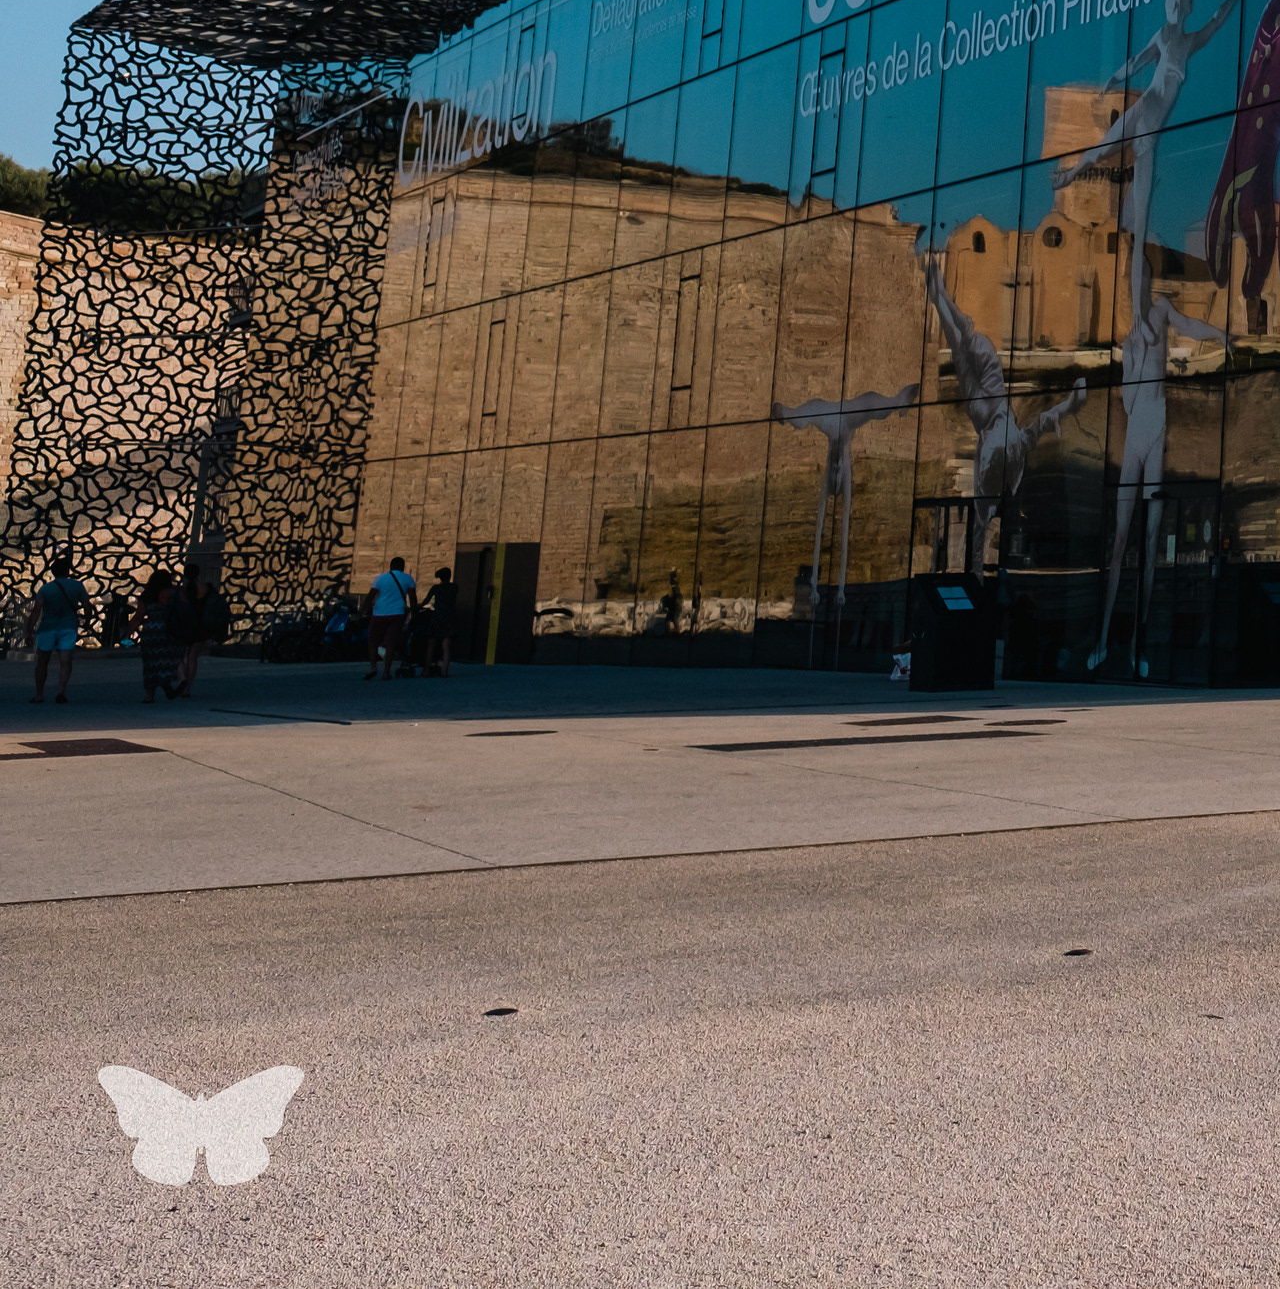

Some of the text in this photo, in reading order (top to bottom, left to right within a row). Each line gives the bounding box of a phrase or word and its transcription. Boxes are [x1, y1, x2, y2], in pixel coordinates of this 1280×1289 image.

[399, 41, 557, 187] Civilization
[799, 58, 877, 118] Œuvres
[881, 41, 909, 85] de
[913, 32, 932, 81] la
